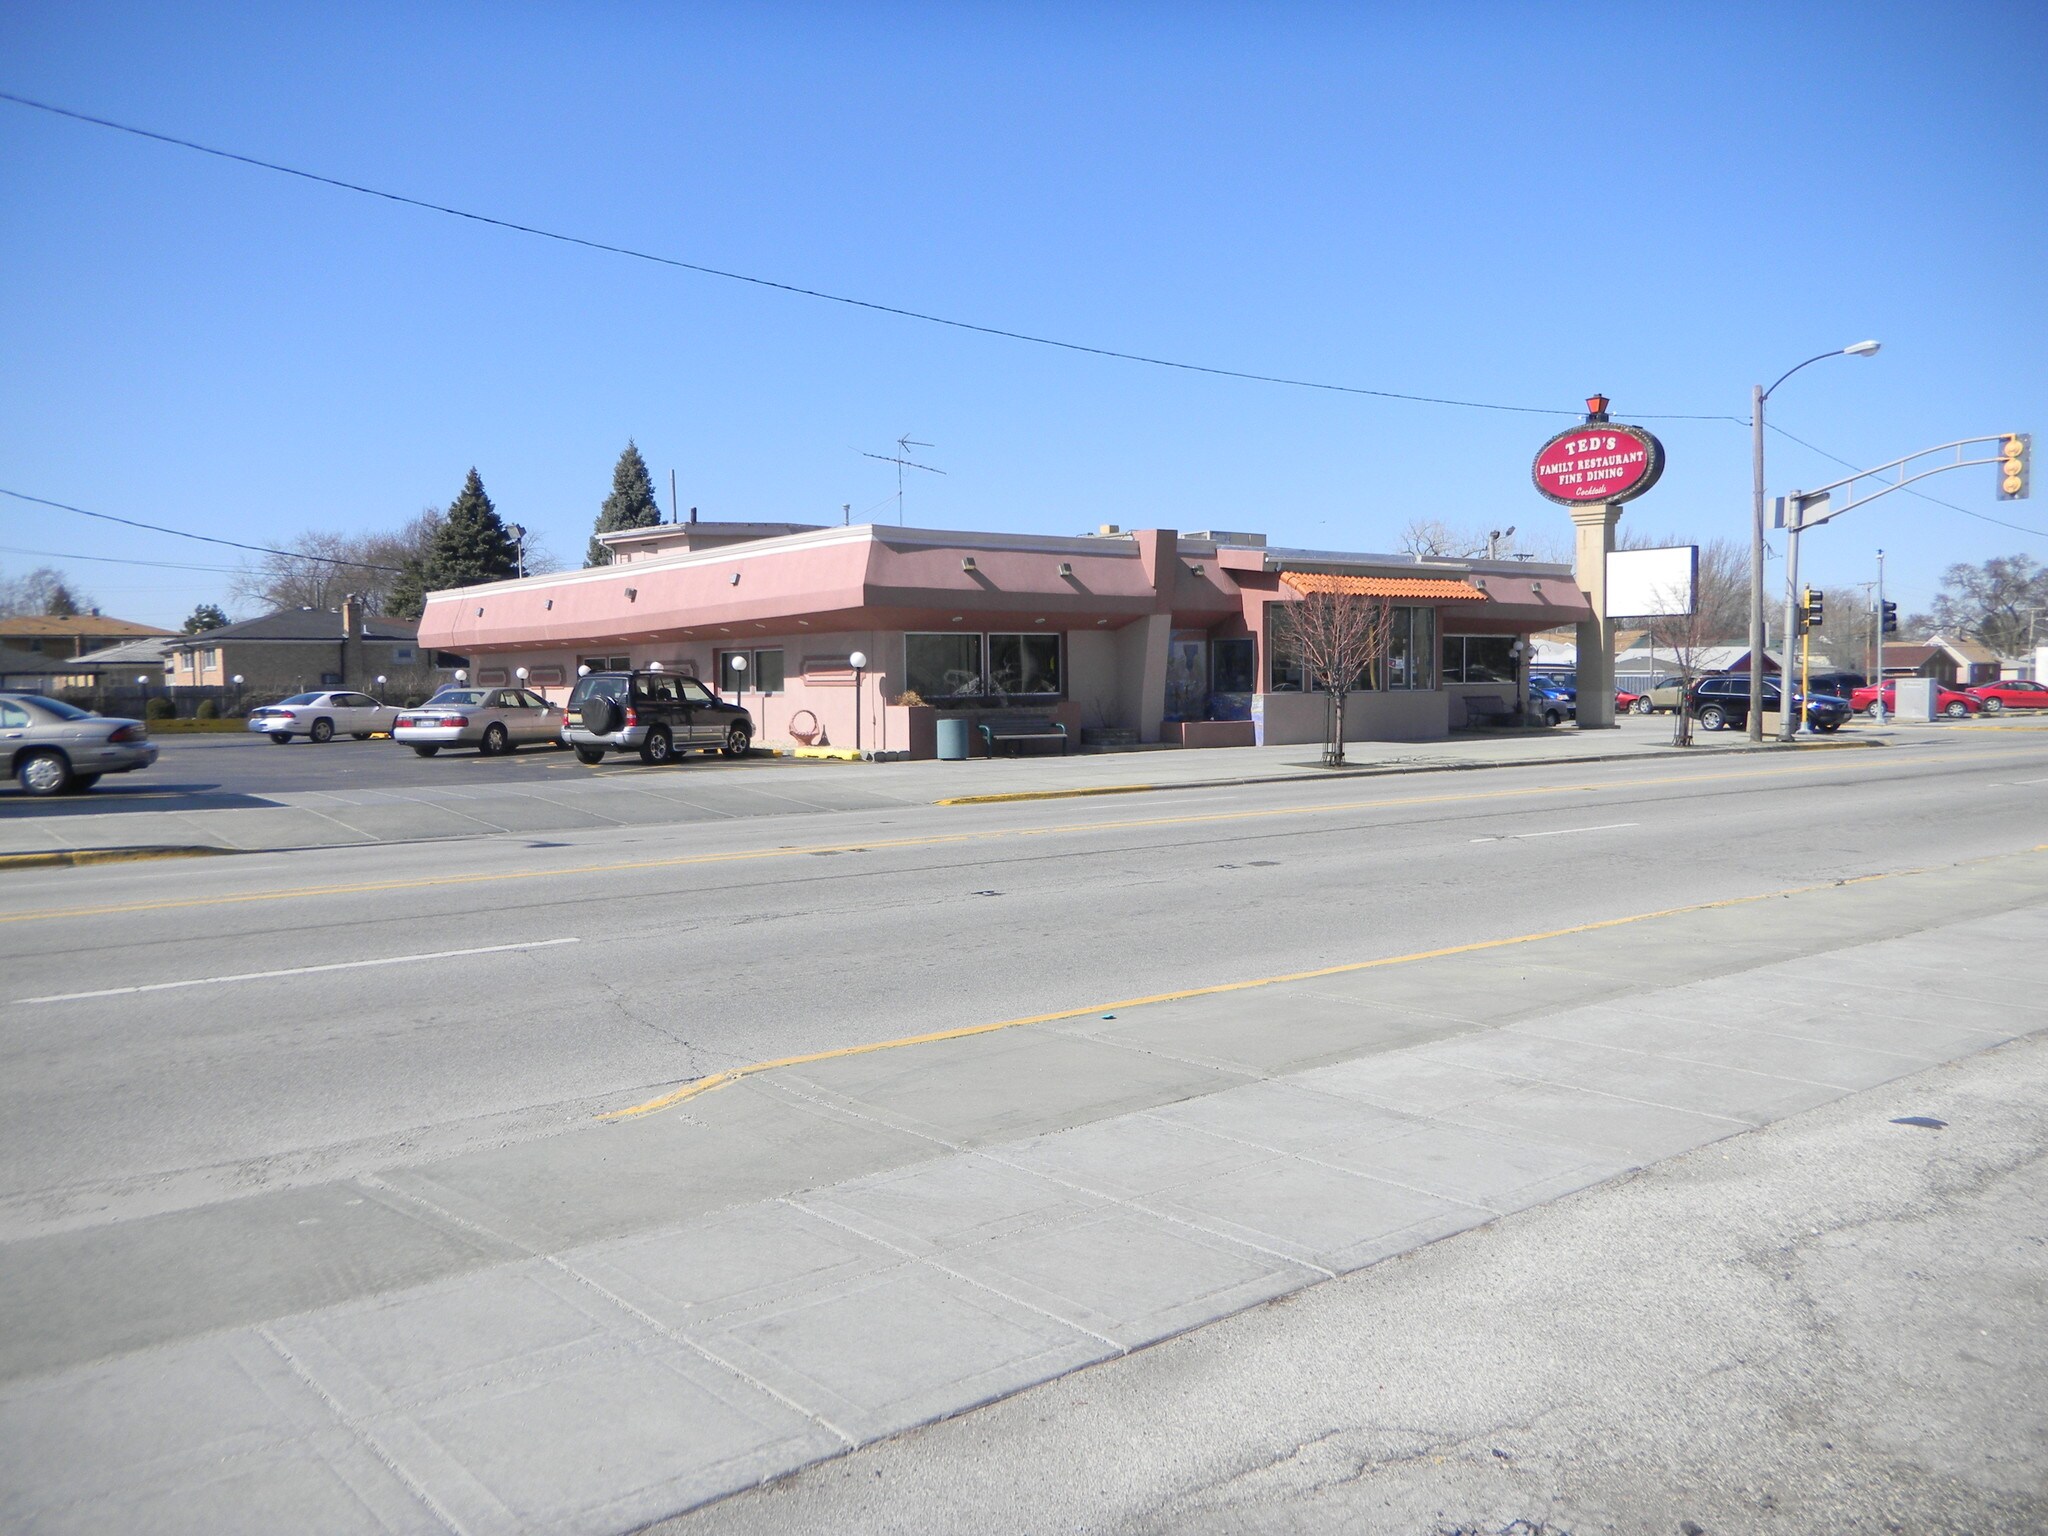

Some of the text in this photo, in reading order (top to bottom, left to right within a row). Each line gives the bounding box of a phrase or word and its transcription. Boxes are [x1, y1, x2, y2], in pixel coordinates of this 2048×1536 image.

[1566, 437, 1616, 455] TED'S
[1540, 451, 1643, 475] FAMILY RESTAURANT
[1559, 467, 1623, 485] FINE DINING
[1576, 484, 1607, 496] Cocktails
